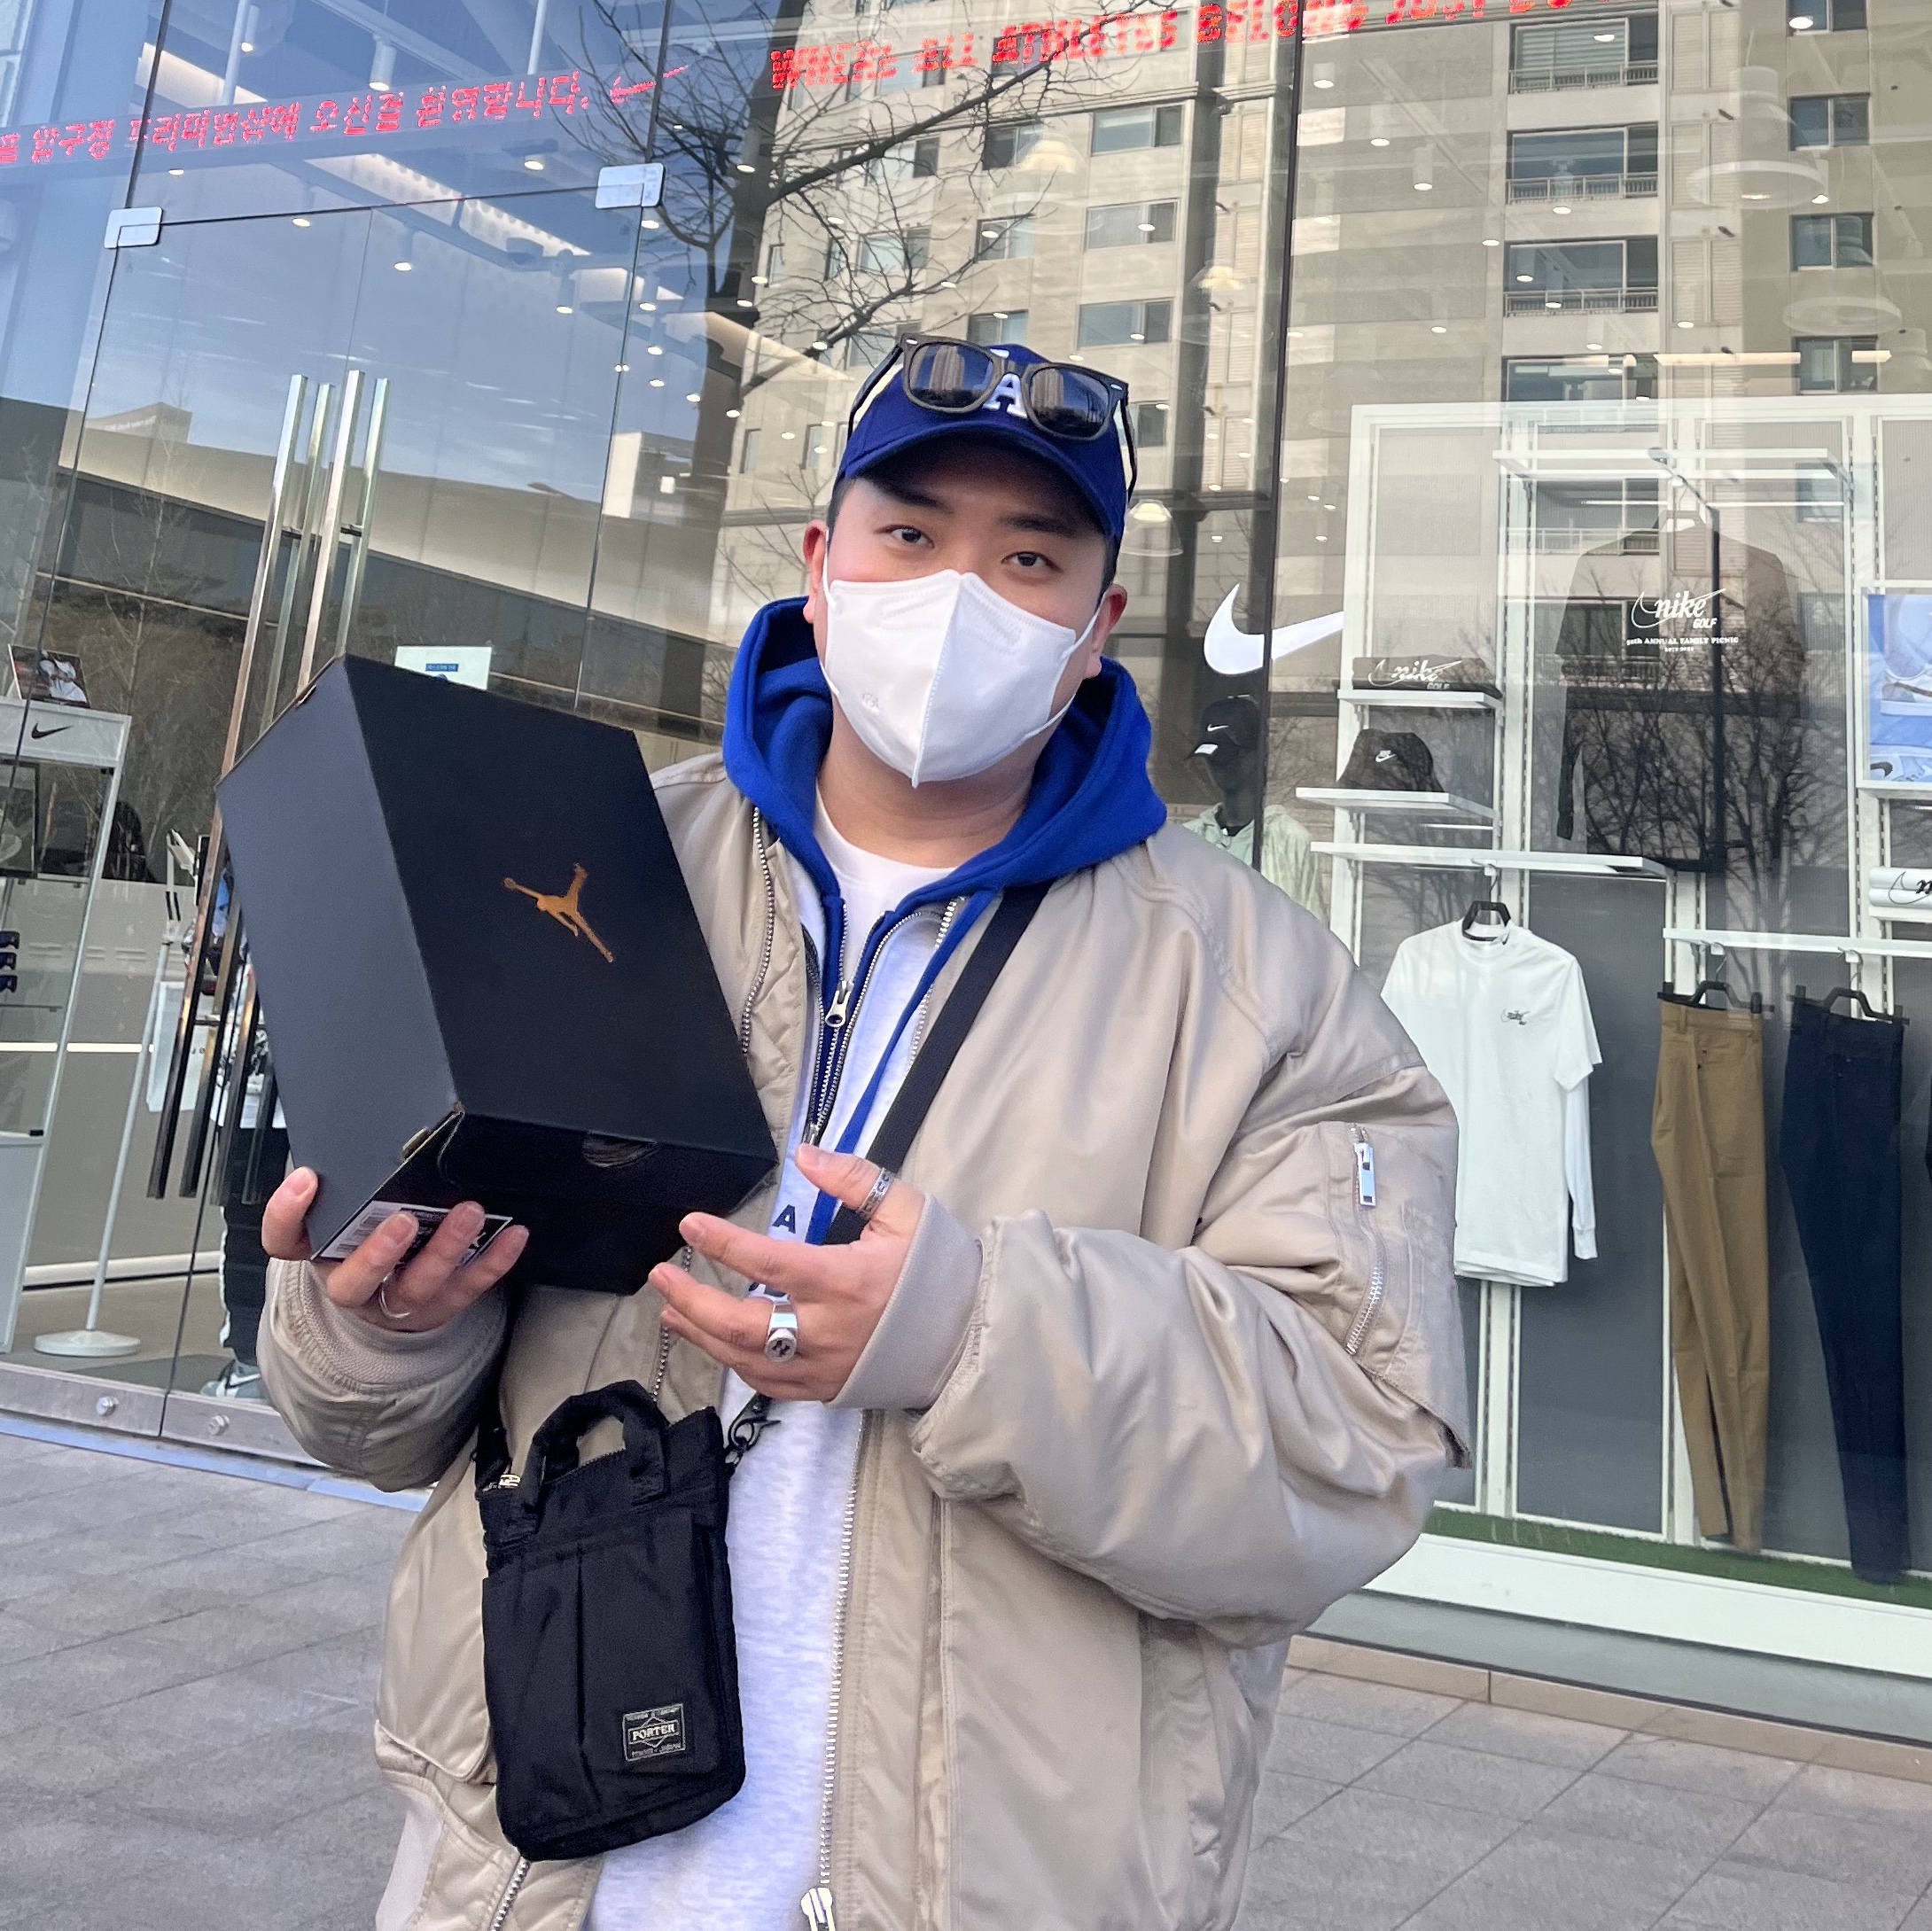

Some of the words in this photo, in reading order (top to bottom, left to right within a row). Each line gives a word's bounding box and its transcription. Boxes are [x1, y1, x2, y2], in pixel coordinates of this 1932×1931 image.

[1692, 618, 1718, 629] GOLF
[772, 1203, 797, 1234] A
[632, 1724, 675, 1741] PORTER
